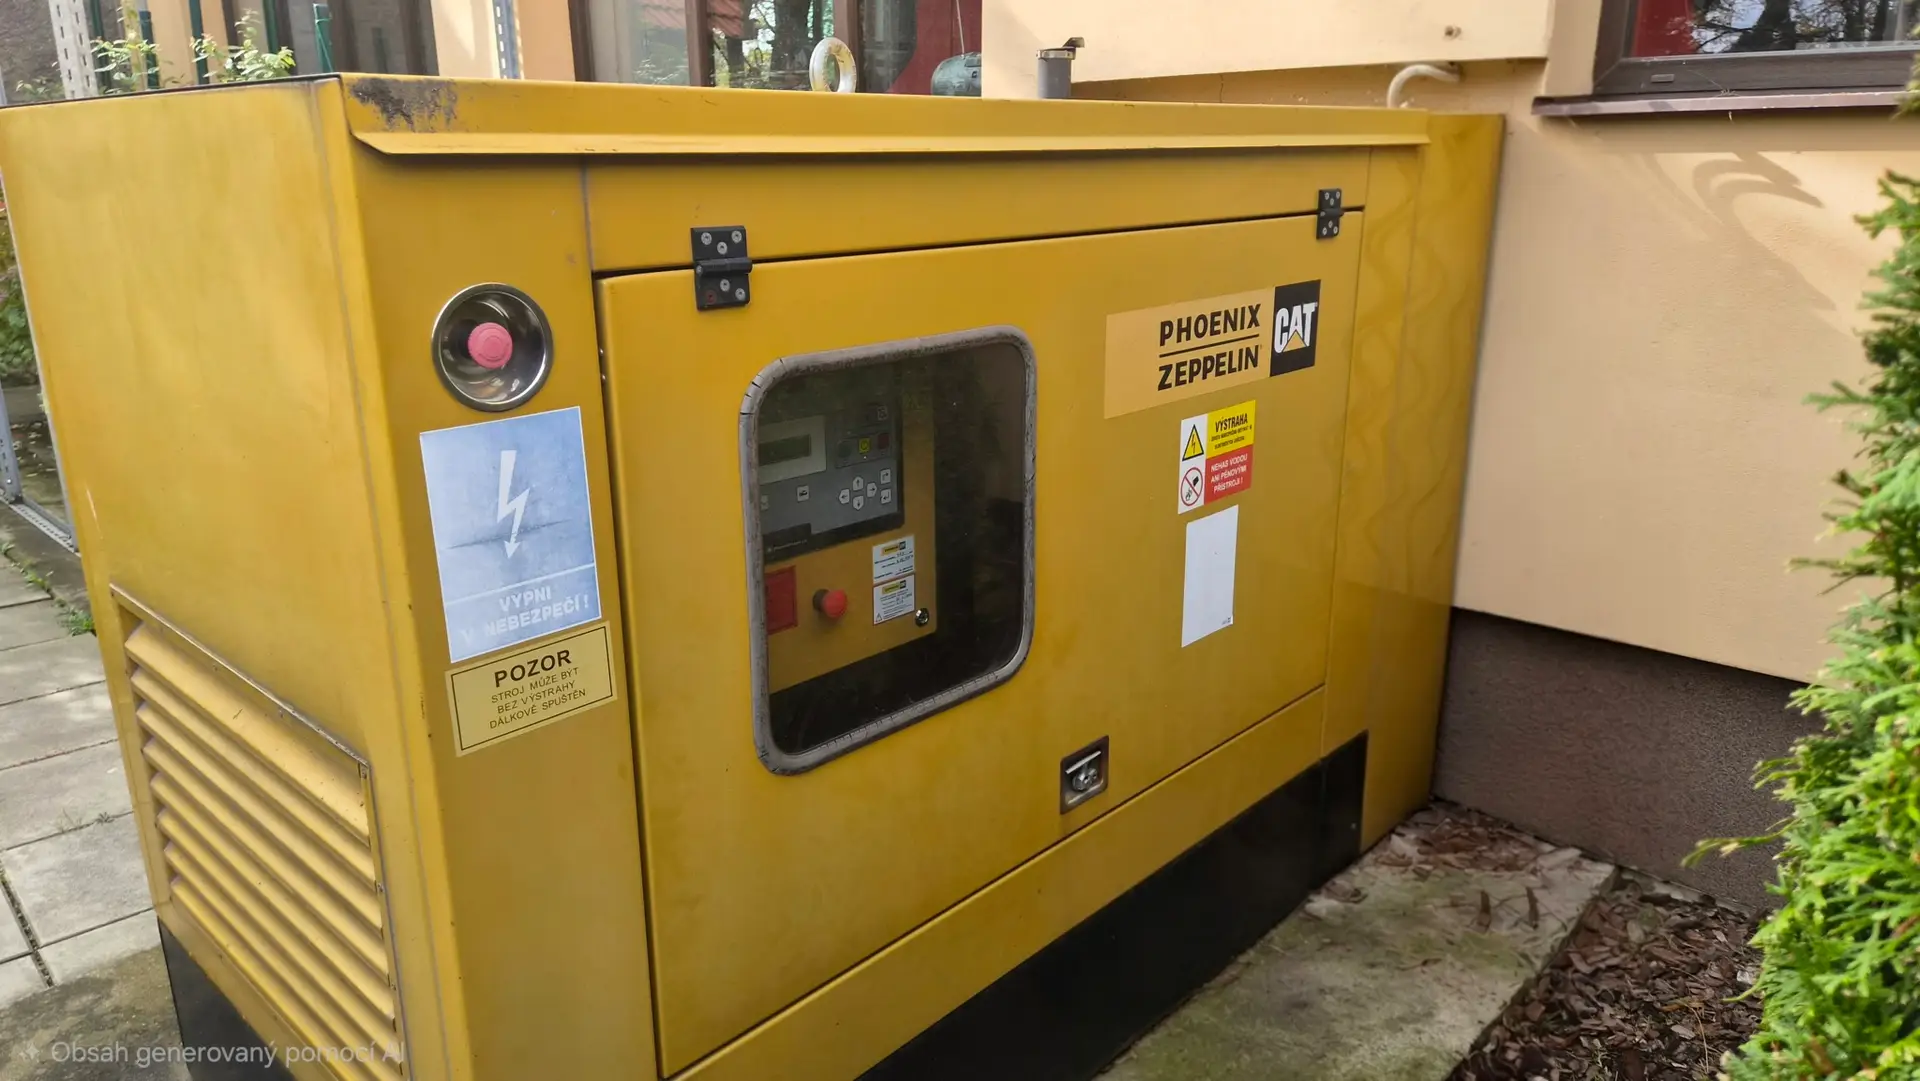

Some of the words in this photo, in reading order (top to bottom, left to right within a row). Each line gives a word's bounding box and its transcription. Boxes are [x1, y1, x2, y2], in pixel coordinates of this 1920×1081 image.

[1159, 303, 1262, 347] PHOENIX
[1274, 302, 1317, 354] CAT
[1157, 344, 1260, 391] ZEPPELIN
[1215, 413, 1248, 433] VÝSTRAHA
[1230, 453, 1248, 466] VODOU
[485, 594, 580, 636] NEBEZPEČÍ
[583, 594, 589, 609] !
[499, 586, 552, 613] VYPNI
[491, 686, 525, 704] STROJ
[530, 673, 558, 690] MŮŽE
[561, 667, 579, 681] BÝT
[494, 649, 572, 688] POZOR
[489, 705, 538, 729] DÁLKOVĚ
[542, 688, 587, 711] SPUŠTĚN
[497, 700, 518, 714] BEZ
[521, 680, 576, 706] VÝSTRAHY
